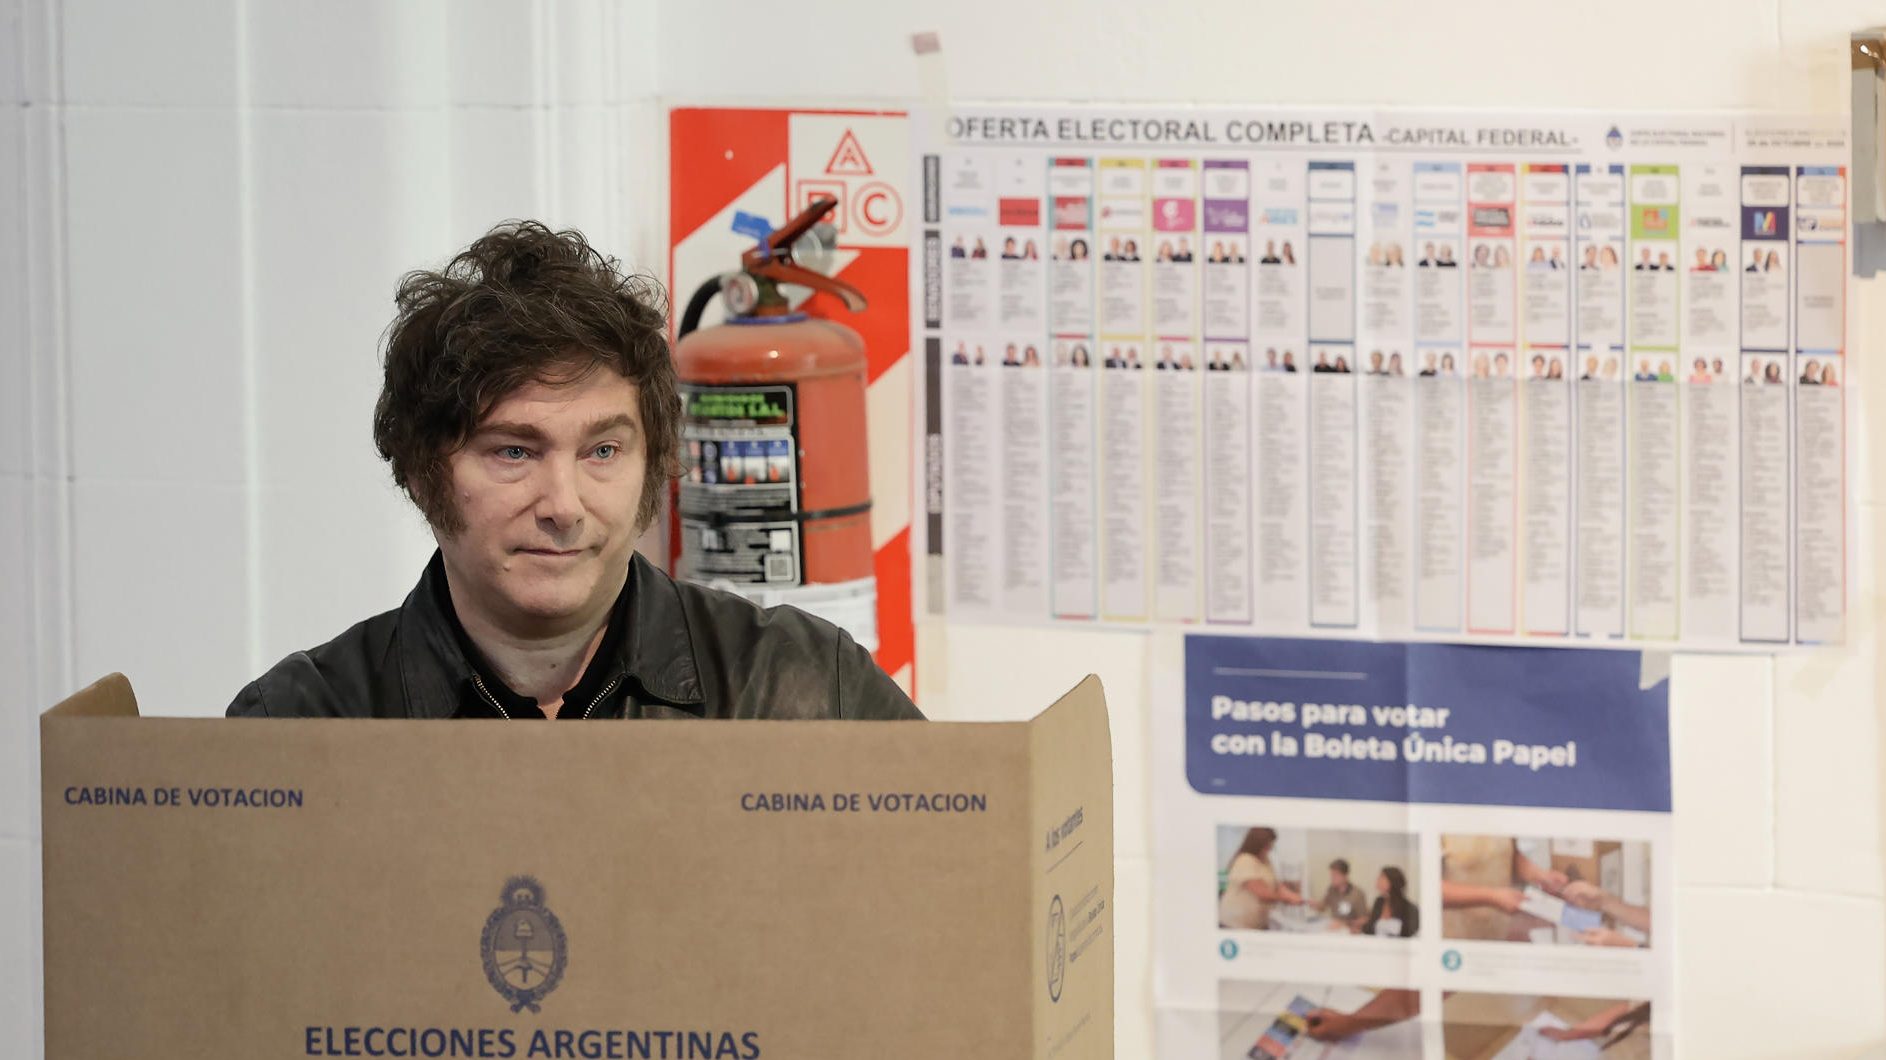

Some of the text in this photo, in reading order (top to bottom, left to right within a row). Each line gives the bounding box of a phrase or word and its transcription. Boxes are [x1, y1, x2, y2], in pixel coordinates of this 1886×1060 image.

[947, 116, 1050, 142] OFERTA
[1057, 118, 1217, 144] ELECTORAL
[1225, 120, 1375, 144] COMPLETA
[863, 192, 887, 226] C
[1211, 696, 1449, 728] Pasos para votar
[1211, 731, 1577, 770] con la Boleta Única Papel
[64, 787, 304, 808] CABINA DE VOTACION
[741, 793, 987, 812] CABINA DE VOTACION
[305, 1026, 761, 1060] ELECCIONES ARGENTINAS
